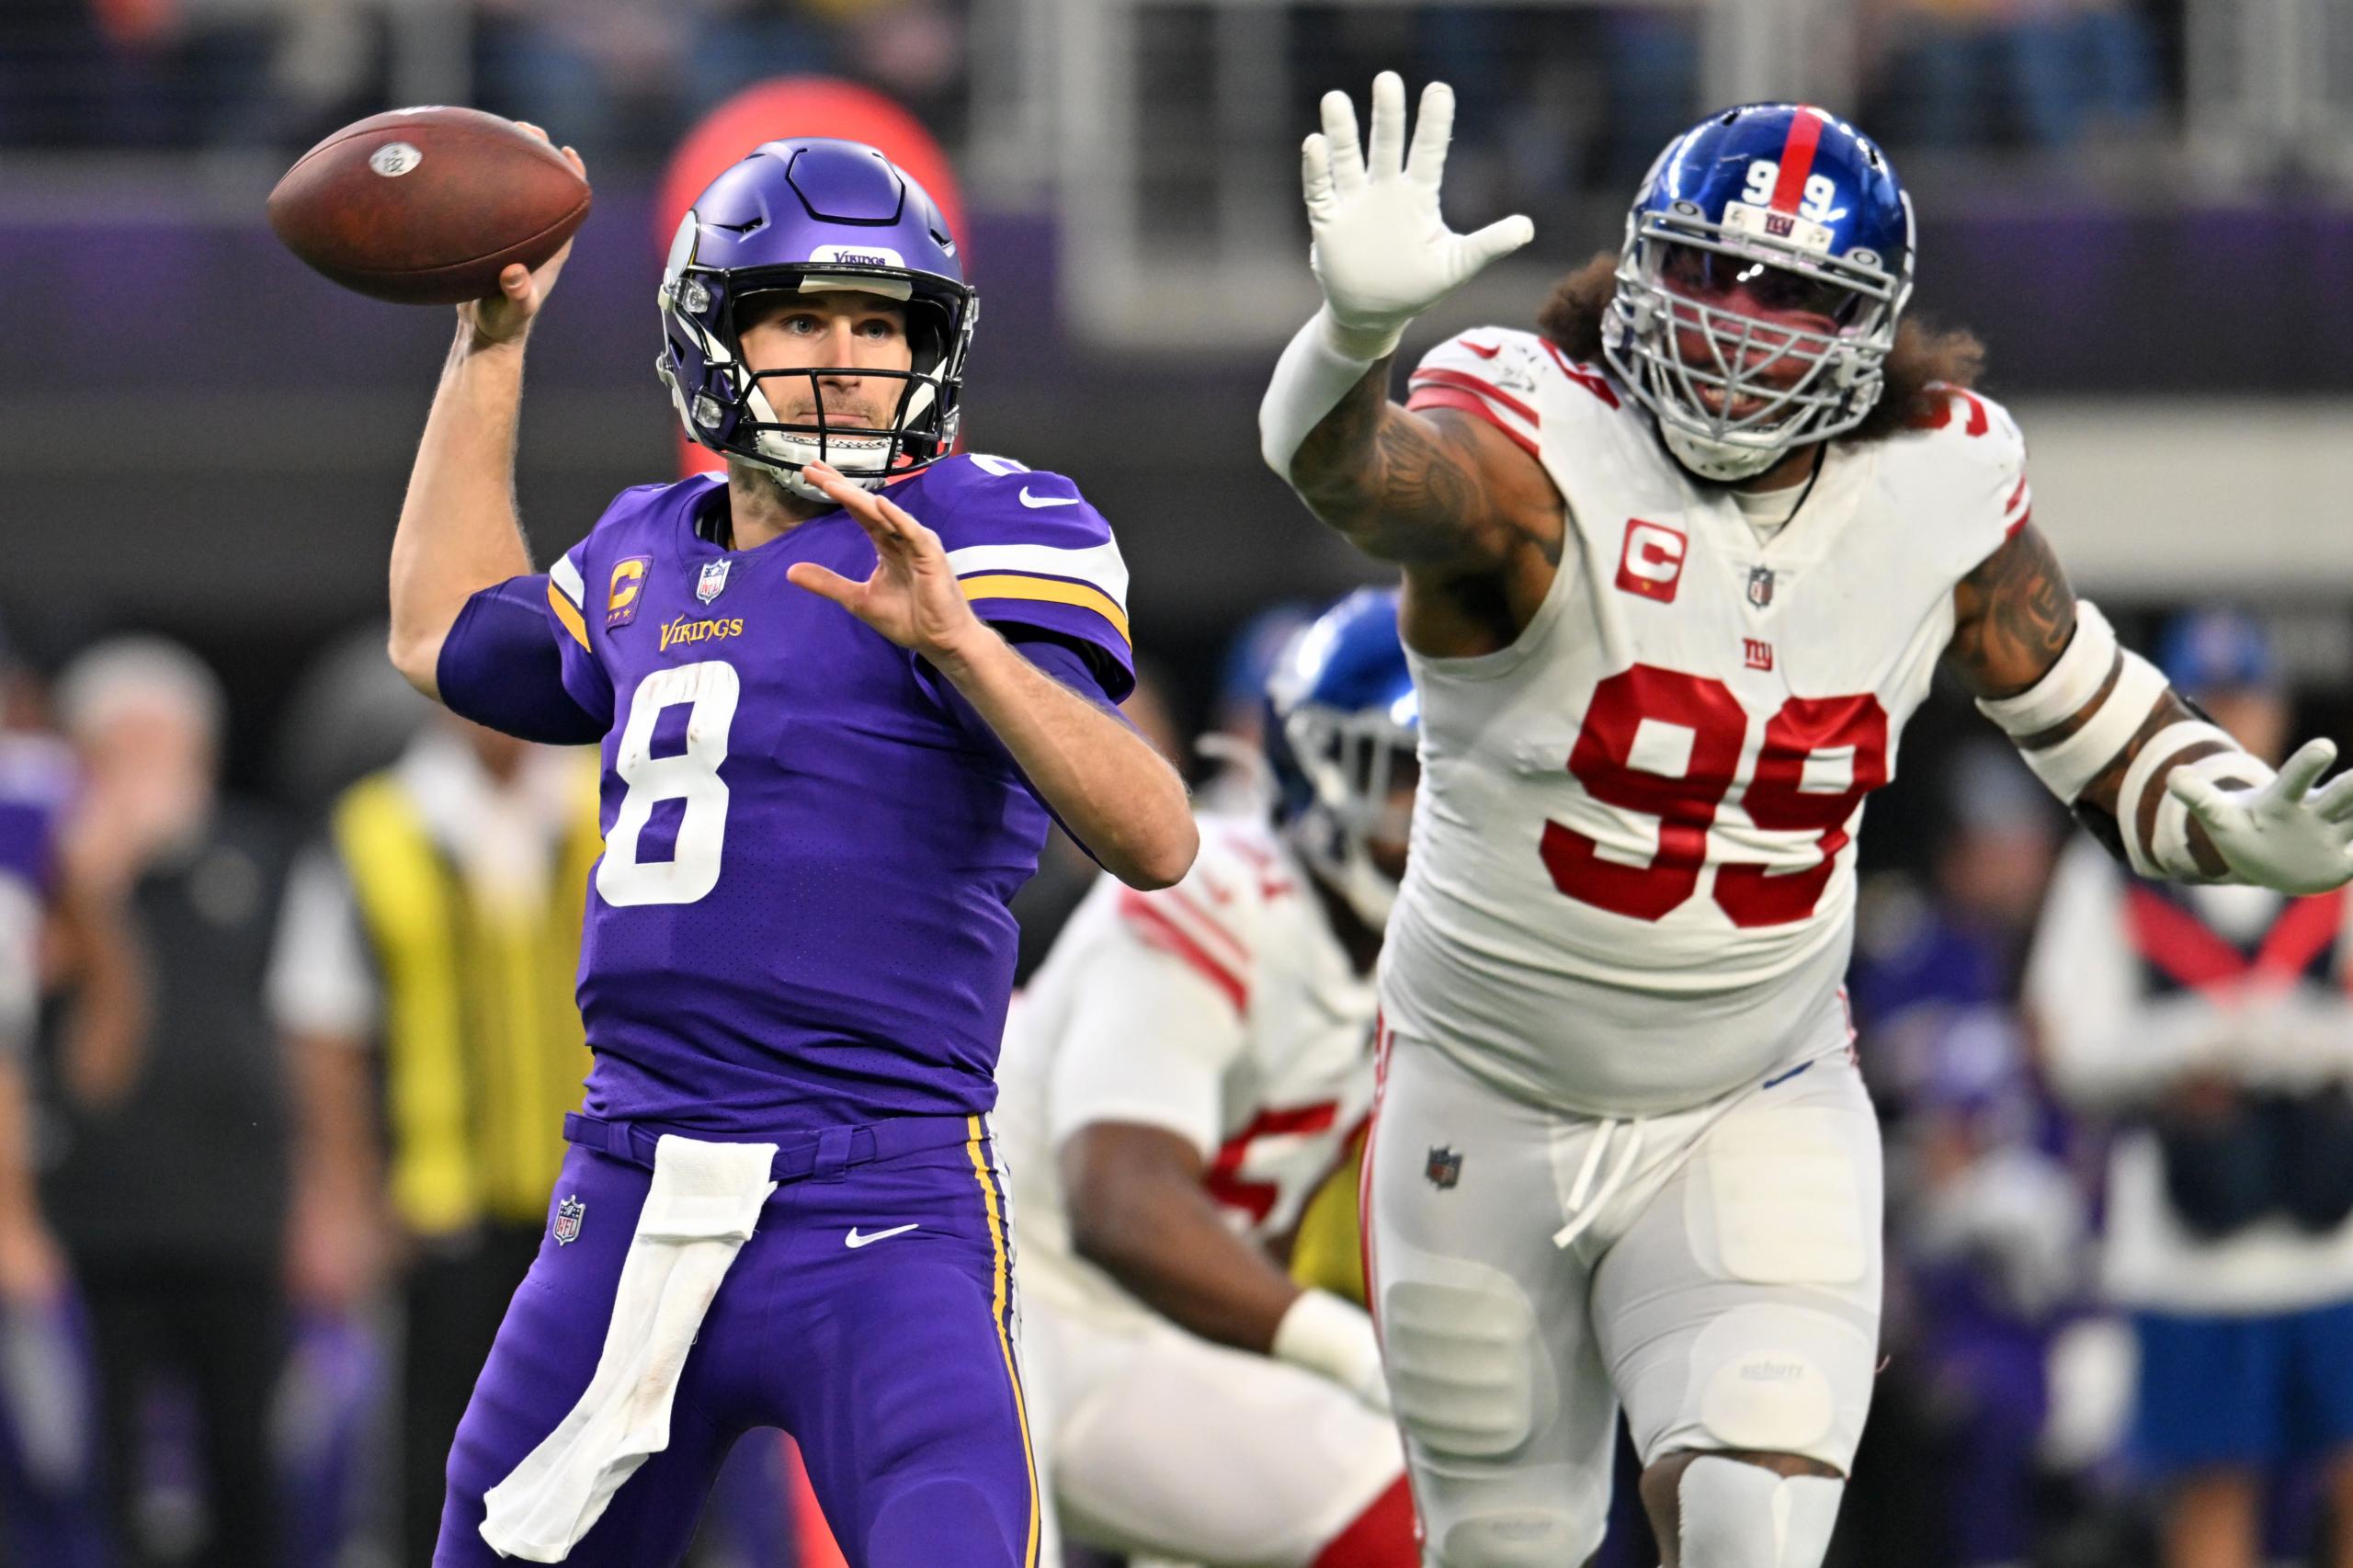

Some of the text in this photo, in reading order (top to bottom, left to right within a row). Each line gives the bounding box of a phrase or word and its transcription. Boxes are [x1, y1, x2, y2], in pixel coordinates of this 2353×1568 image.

[1626, 526, 1683, 583] C
[608, 560, 644, 612] C
[596, 660, 741, 907] 8
[1539, 662, 1888, 929] 99
[558, 1217, 575, 1236] NFL
